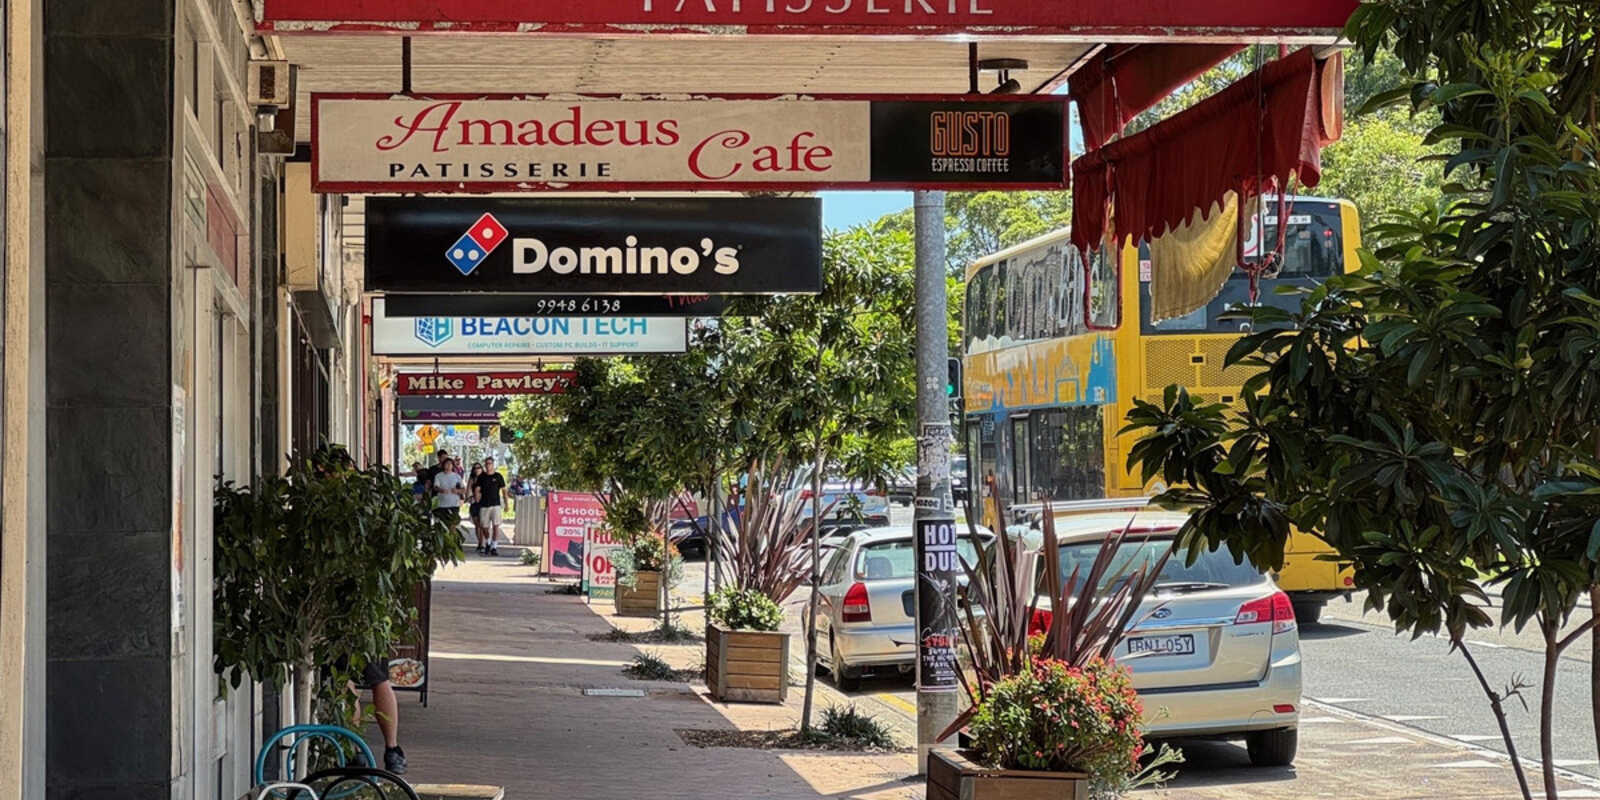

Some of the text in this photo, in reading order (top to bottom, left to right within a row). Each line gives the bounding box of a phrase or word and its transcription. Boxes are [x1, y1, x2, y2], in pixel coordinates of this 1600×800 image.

[376, 102, 833, 180] Amadeus Cafe
[930, 111, 1010, 156] GUSTO
[389, 163, 612, 178] PATISSERIE
[931, 157, 1009, 173] ESPRESSO COFFEE
[512, 235, 740, 275] Domino's
[536, 298, 621, 314] 9948 6138
[461, 317, 569, 336] BEACON
[407, 375, 465, 390] Mike
[557, 506, 601, 516] SCHOOL
